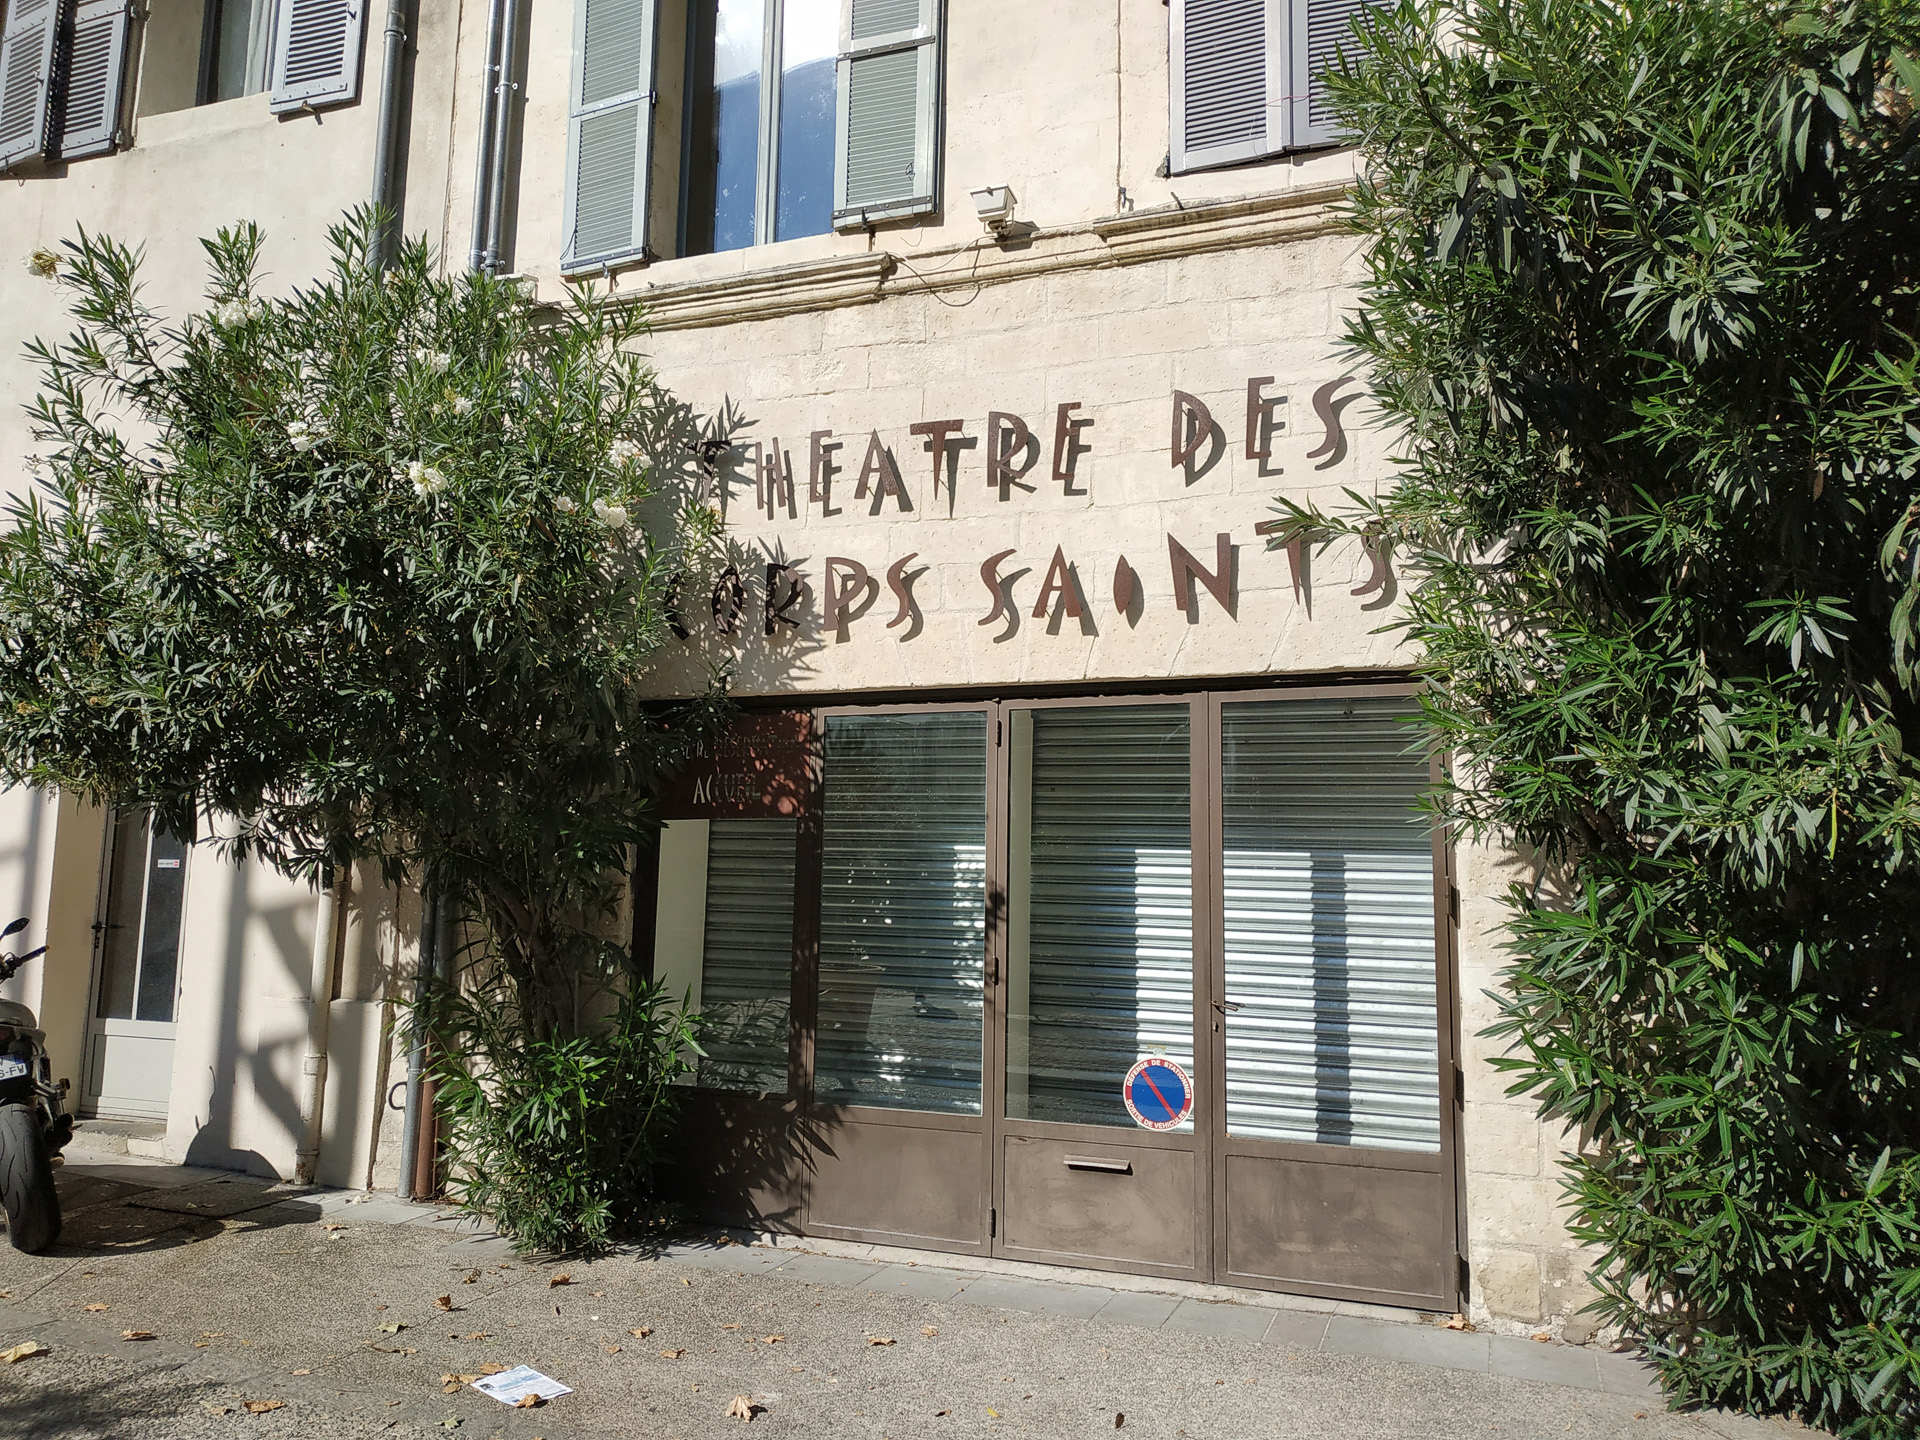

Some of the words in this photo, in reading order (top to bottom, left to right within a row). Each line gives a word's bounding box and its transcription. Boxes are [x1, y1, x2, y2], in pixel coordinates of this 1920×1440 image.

[684, 401, 1082, 509] THEATRE
[1171, 376, 1357, 469] DES
[664, 552, 920, 640] CORPS
[977, 514, 1392, 626] SAINTS
[1126, 1098, 1144, 1123] SORTIE
[1143, 1119, 1153, 1128] DE
[1163, 1061, 1191, 1099] STATIONNER
